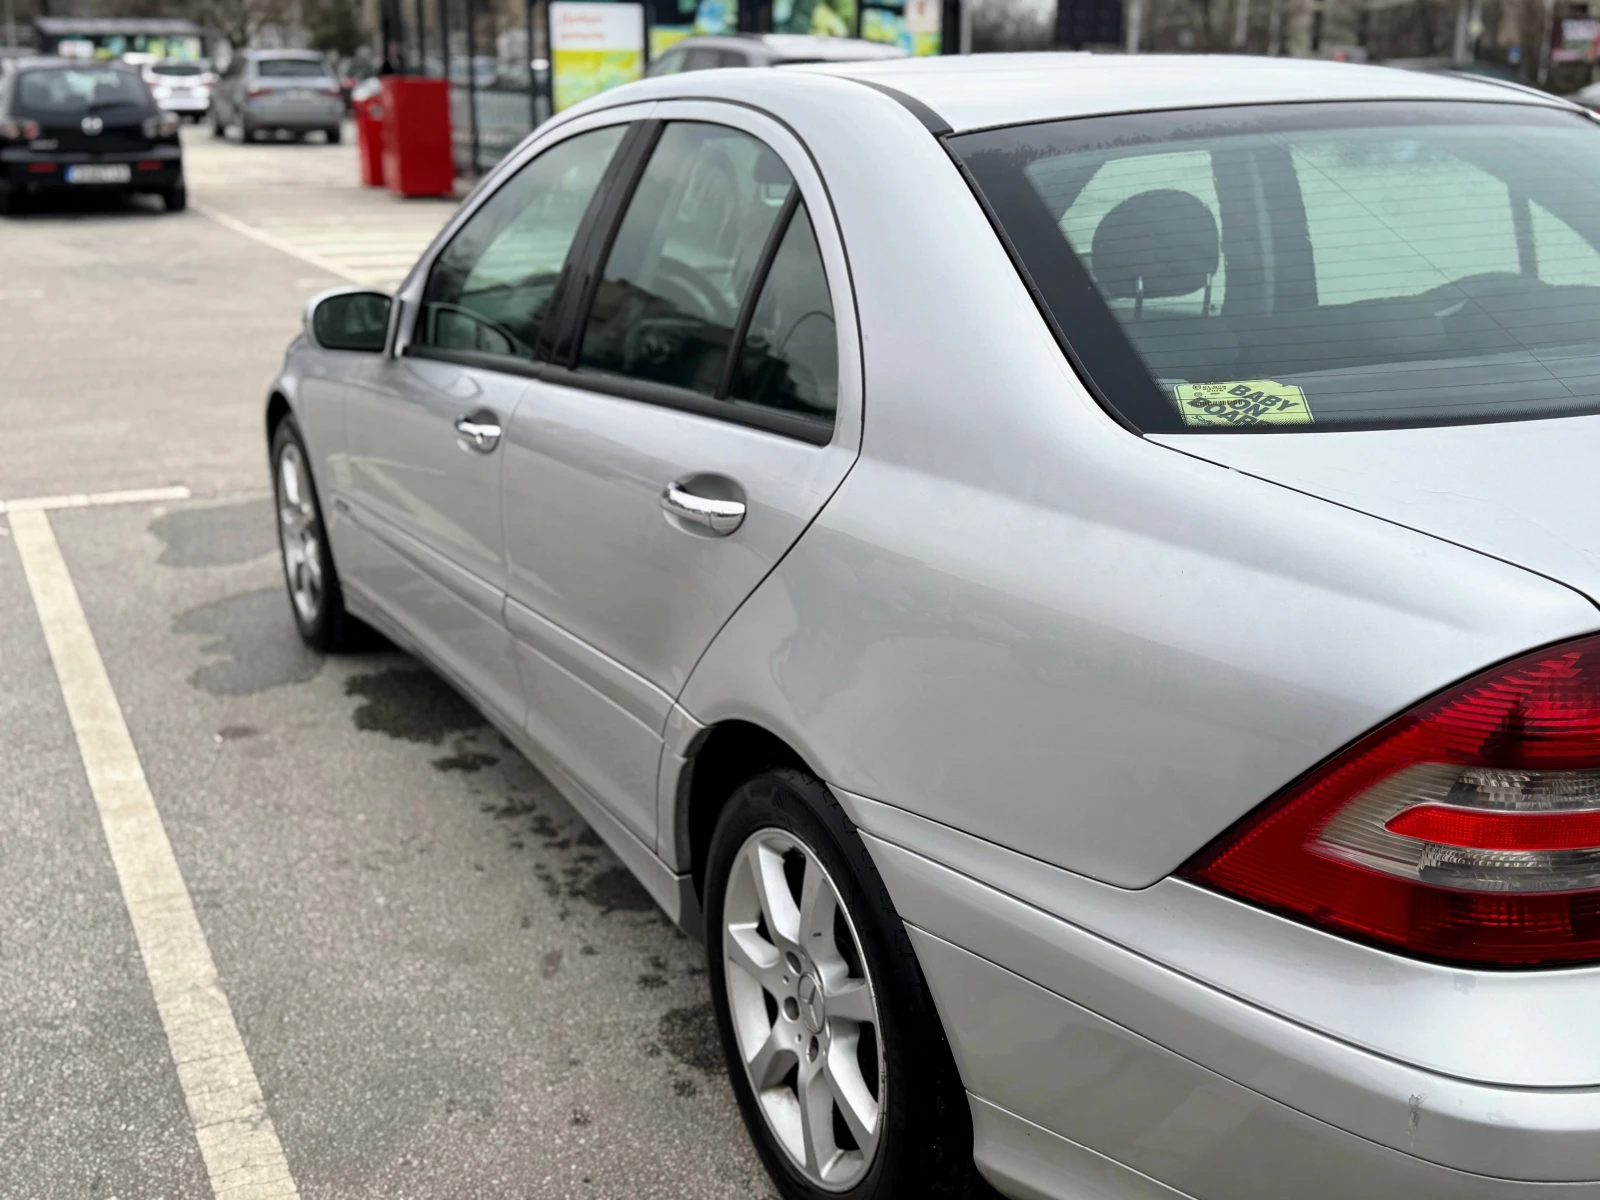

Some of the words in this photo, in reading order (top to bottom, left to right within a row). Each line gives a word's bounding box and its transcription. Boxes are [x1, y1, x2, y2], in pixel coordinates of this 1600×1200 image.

[1187, 397, 1270, 425] BOAR
[1228, 385, 1299, 411] BABY
[1230, 398, 1270, 417] ON
